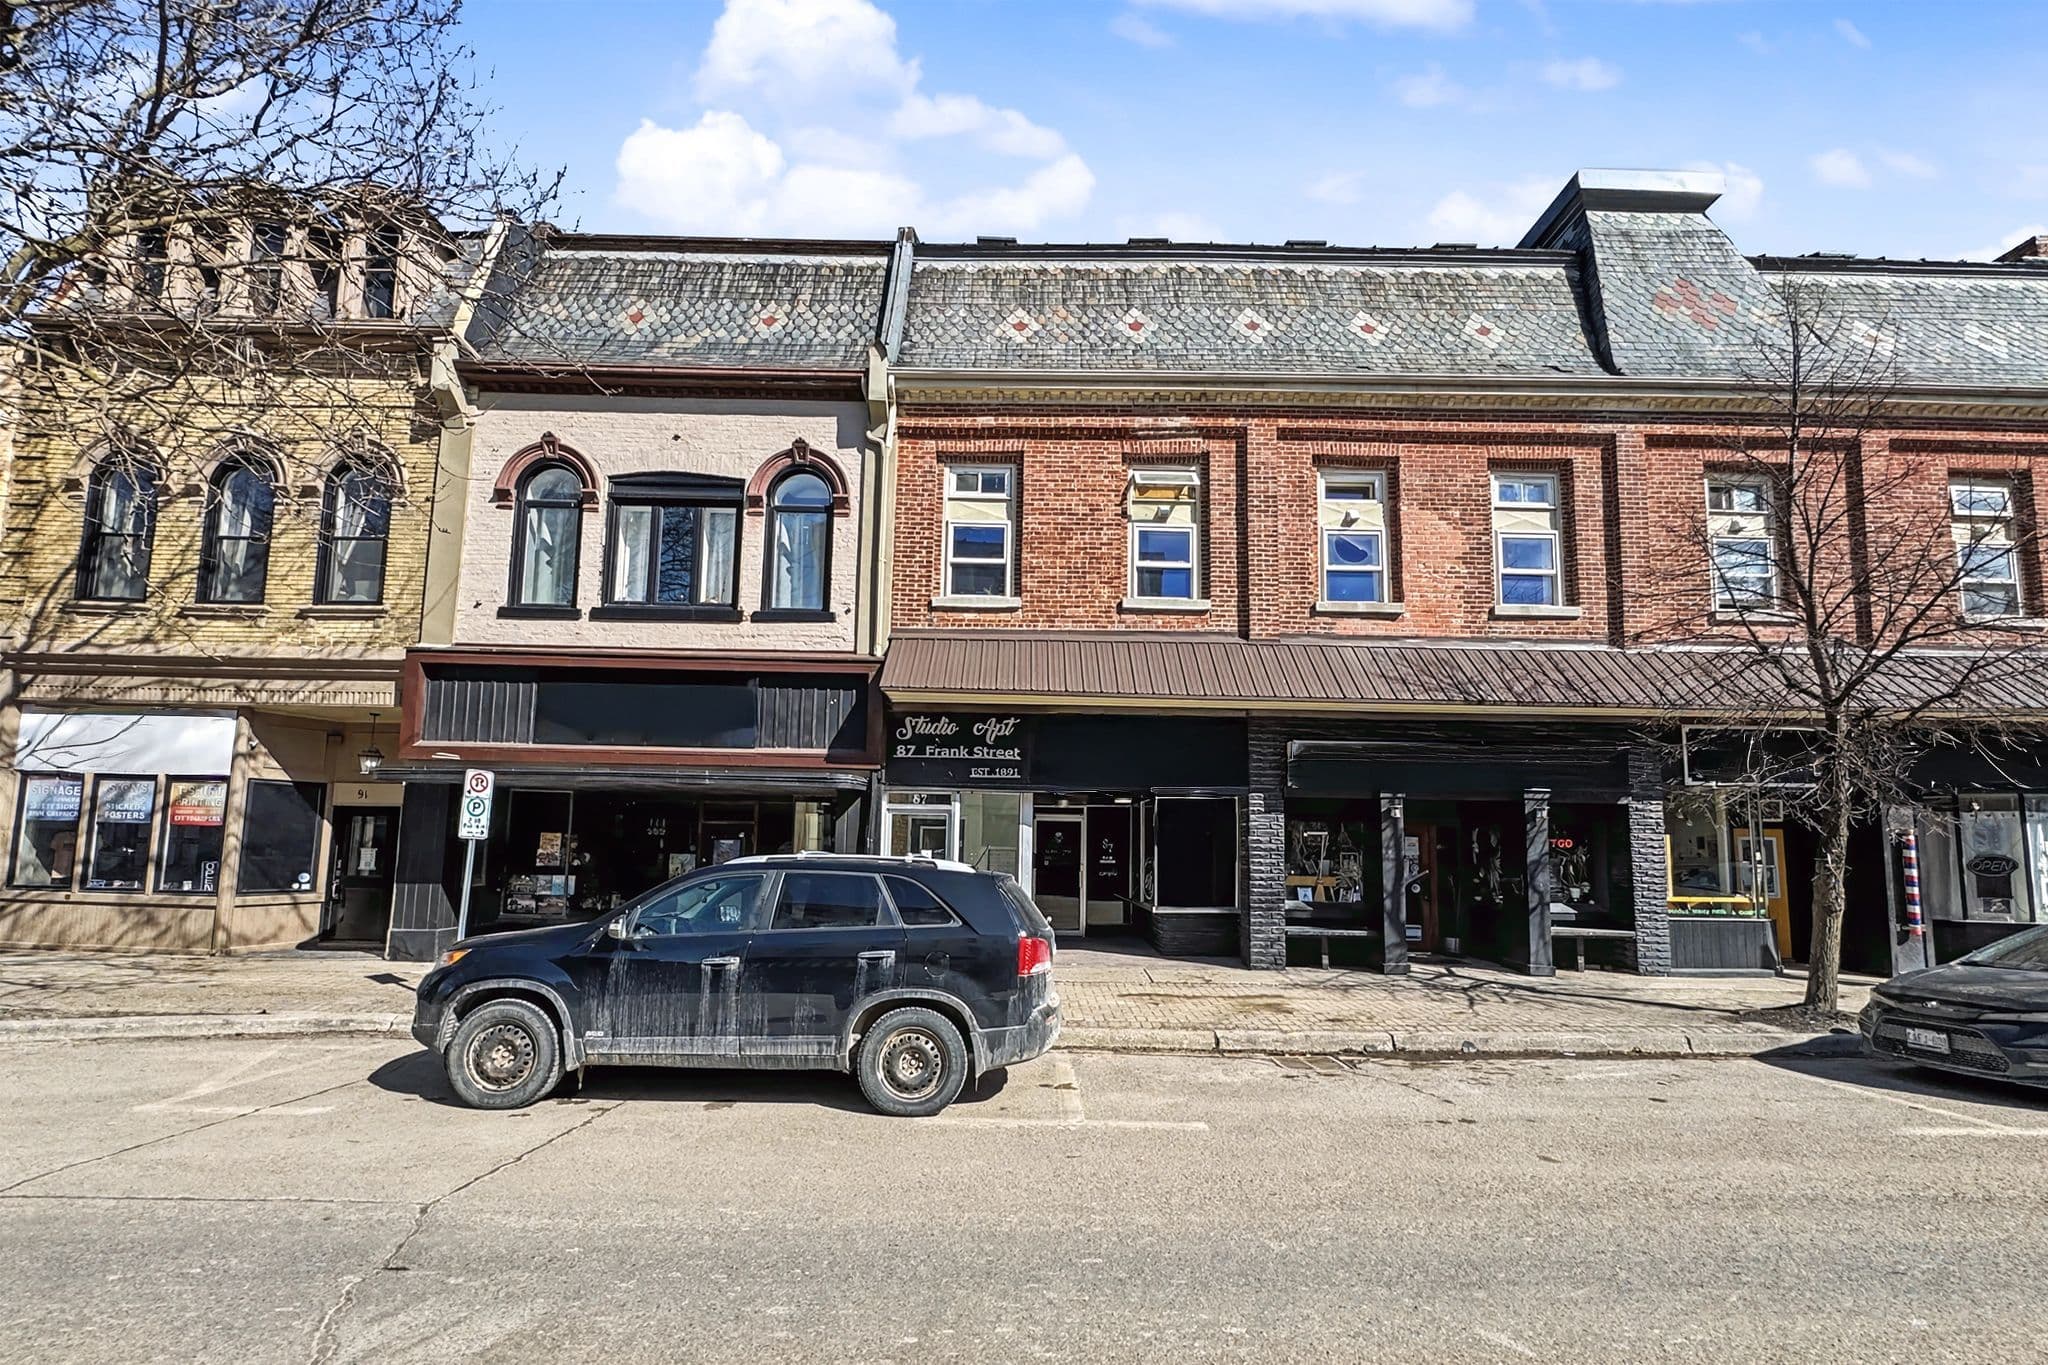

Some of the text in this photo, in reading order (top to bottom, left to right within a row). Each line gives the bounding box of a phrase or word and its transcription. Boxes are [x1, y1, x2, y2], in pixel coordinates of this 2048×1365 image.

[896, 715, 1020, 744] Studio Apt
[896, 745, 1020, 760] 87 Frank Street
[995, 767, 1019, 776] 1891
[31, 784, 81, 796] SIGNAGE
[357, 789, 368, 799] 91
[912, 793, 928, 804] 87
[1971, 860, 2013, 872] OPEN
